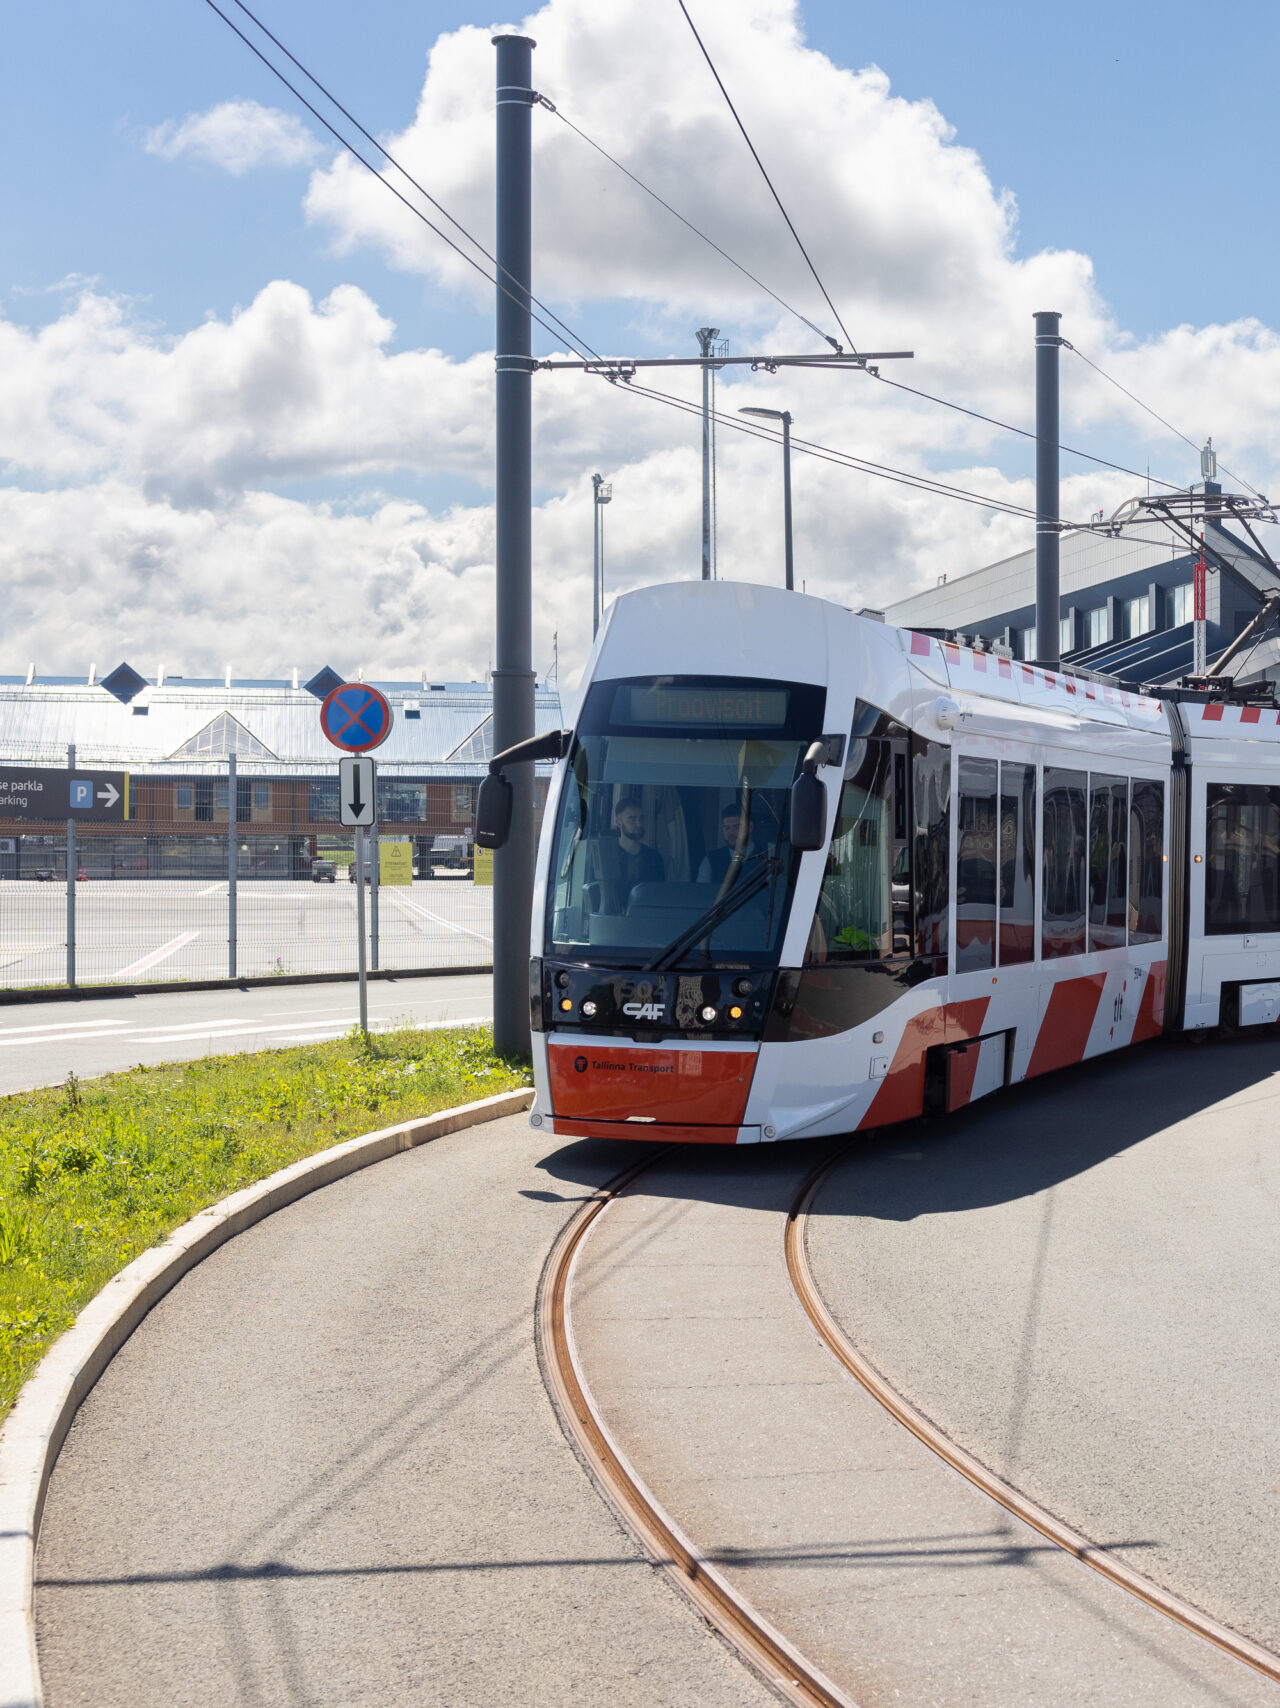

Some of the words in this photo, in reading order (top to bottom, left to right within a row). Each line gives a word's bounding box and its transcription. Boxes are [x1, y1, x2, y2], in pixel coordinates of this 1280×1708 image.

[11, 780, 43, 792] parkla
[76, 786, 88, 803] P
[622, 1002, 666, 1020] CAF
[591, 1060, 626, 1072] Tallinna
[628, 1062, 675, 1073] Transport
